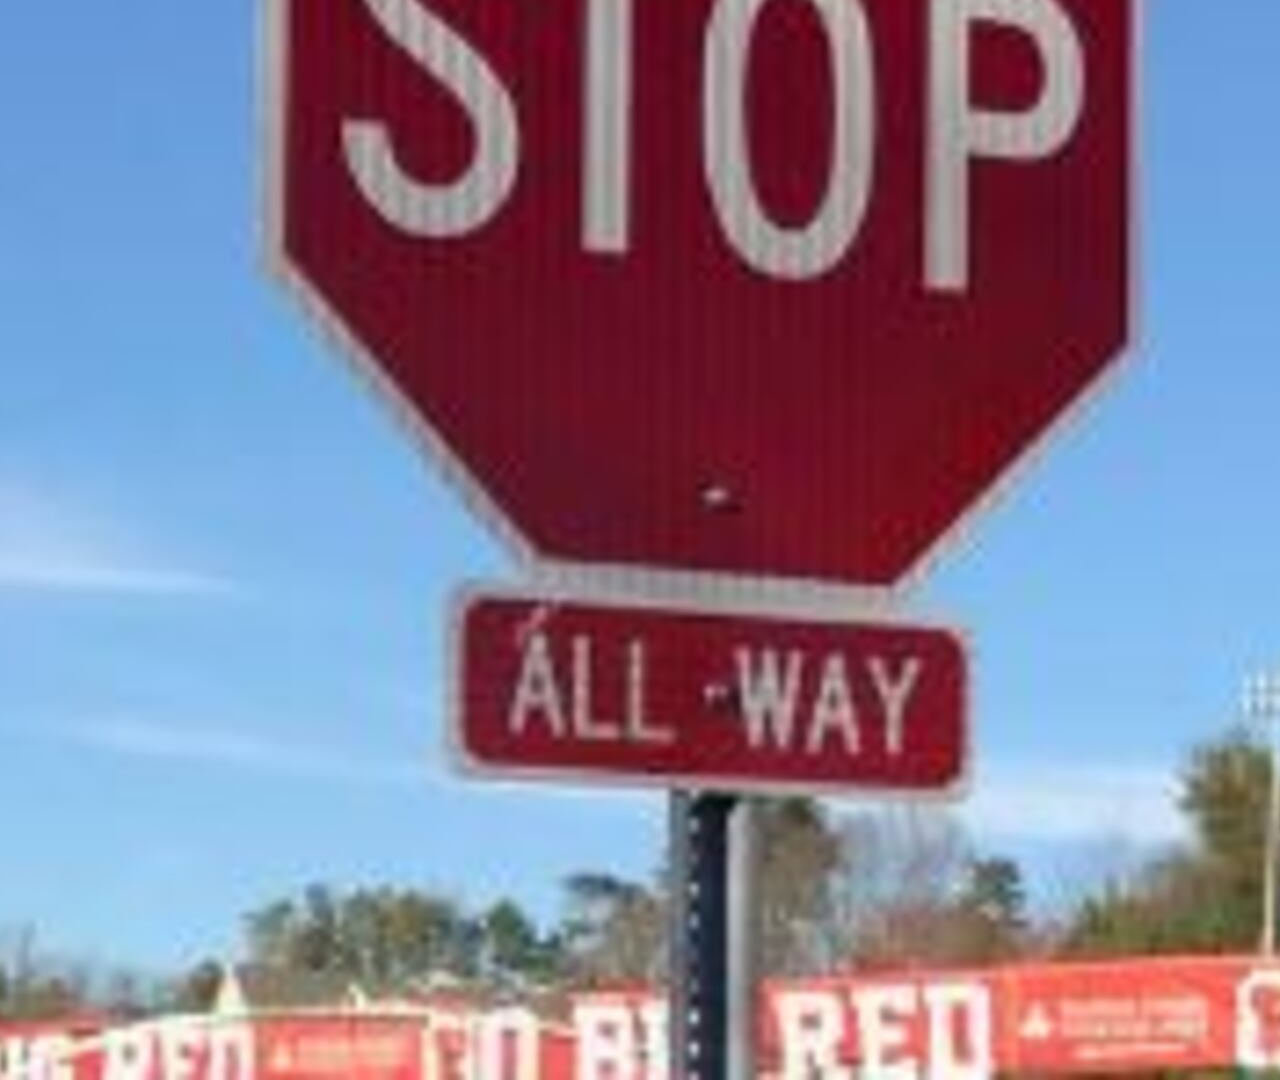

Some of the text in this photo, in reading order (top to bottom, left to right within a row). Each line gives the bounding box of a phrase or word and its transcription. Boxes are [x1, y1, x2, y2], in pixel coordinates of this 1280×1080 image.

[508, 631, 920, 756] ALL WAY
[572, 998, 670, 1080] BI
[765, 982, 991, 1080] RED
